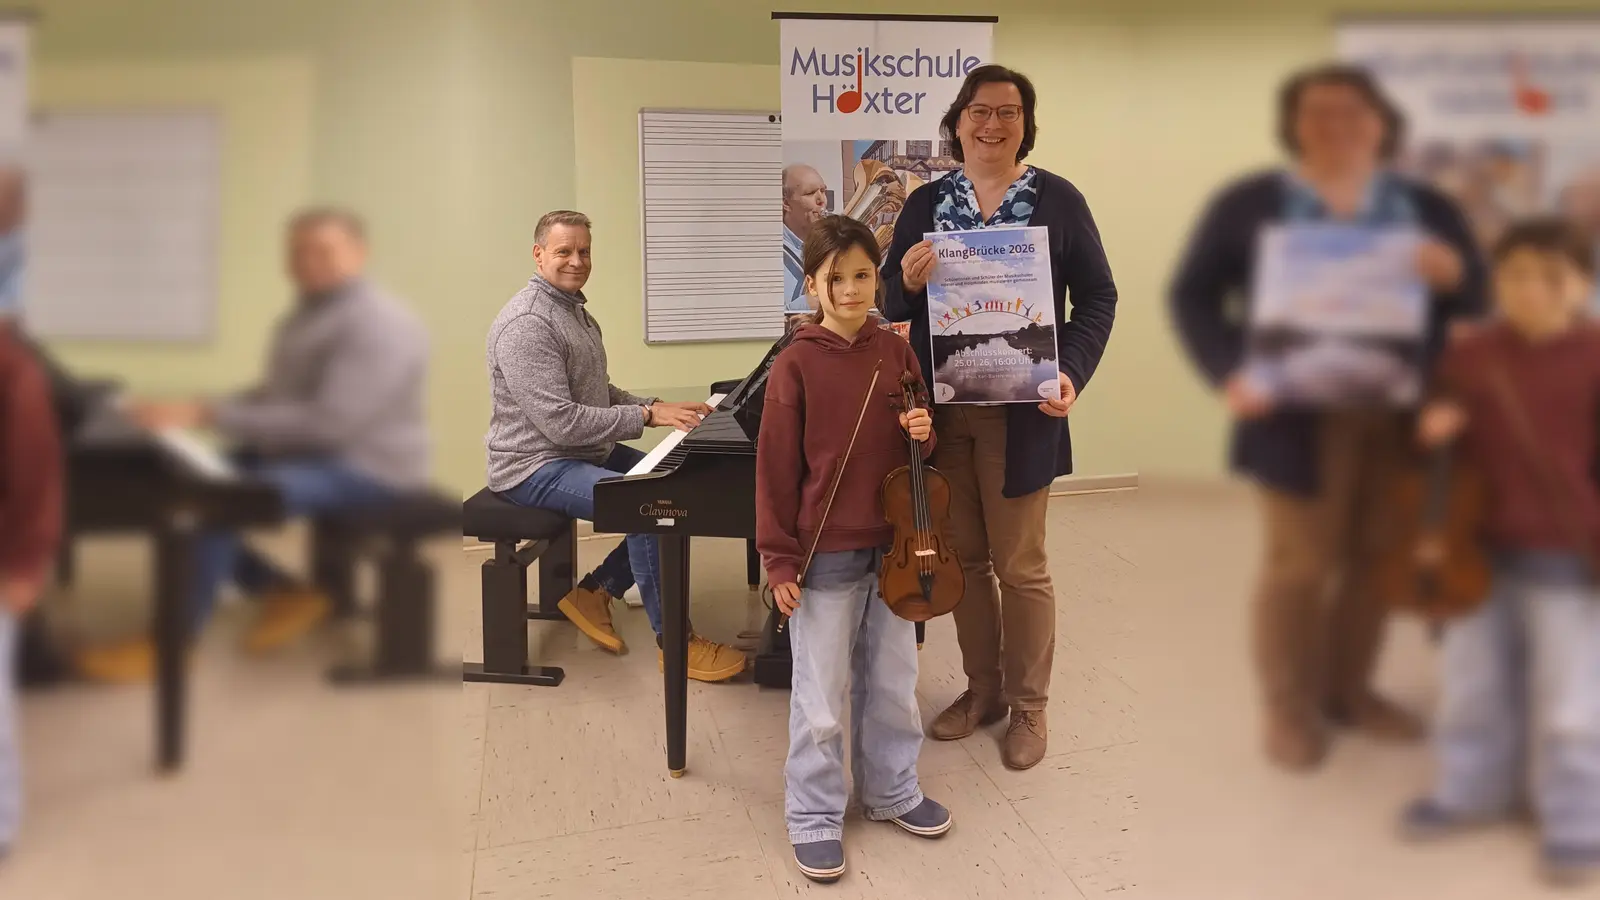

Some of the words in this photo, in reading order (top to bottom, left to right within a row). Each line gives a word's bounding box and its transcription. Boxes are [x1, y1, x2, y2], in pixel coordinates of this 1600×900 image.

[789, 46, 981, 78] Musikschule
[812, 84, 927, 114] Höxter
[938, 245, 1006, 259] KlangBrücke
[1008, 244, 1035, 254] 2026
[955, 347, 1033, 357] Abschlusskonzert:
[994, 357, 1017, 366] 16:00
[1018, 356, 1035, 365] Uhr
[639, 503, 688, 517] Clavinova
